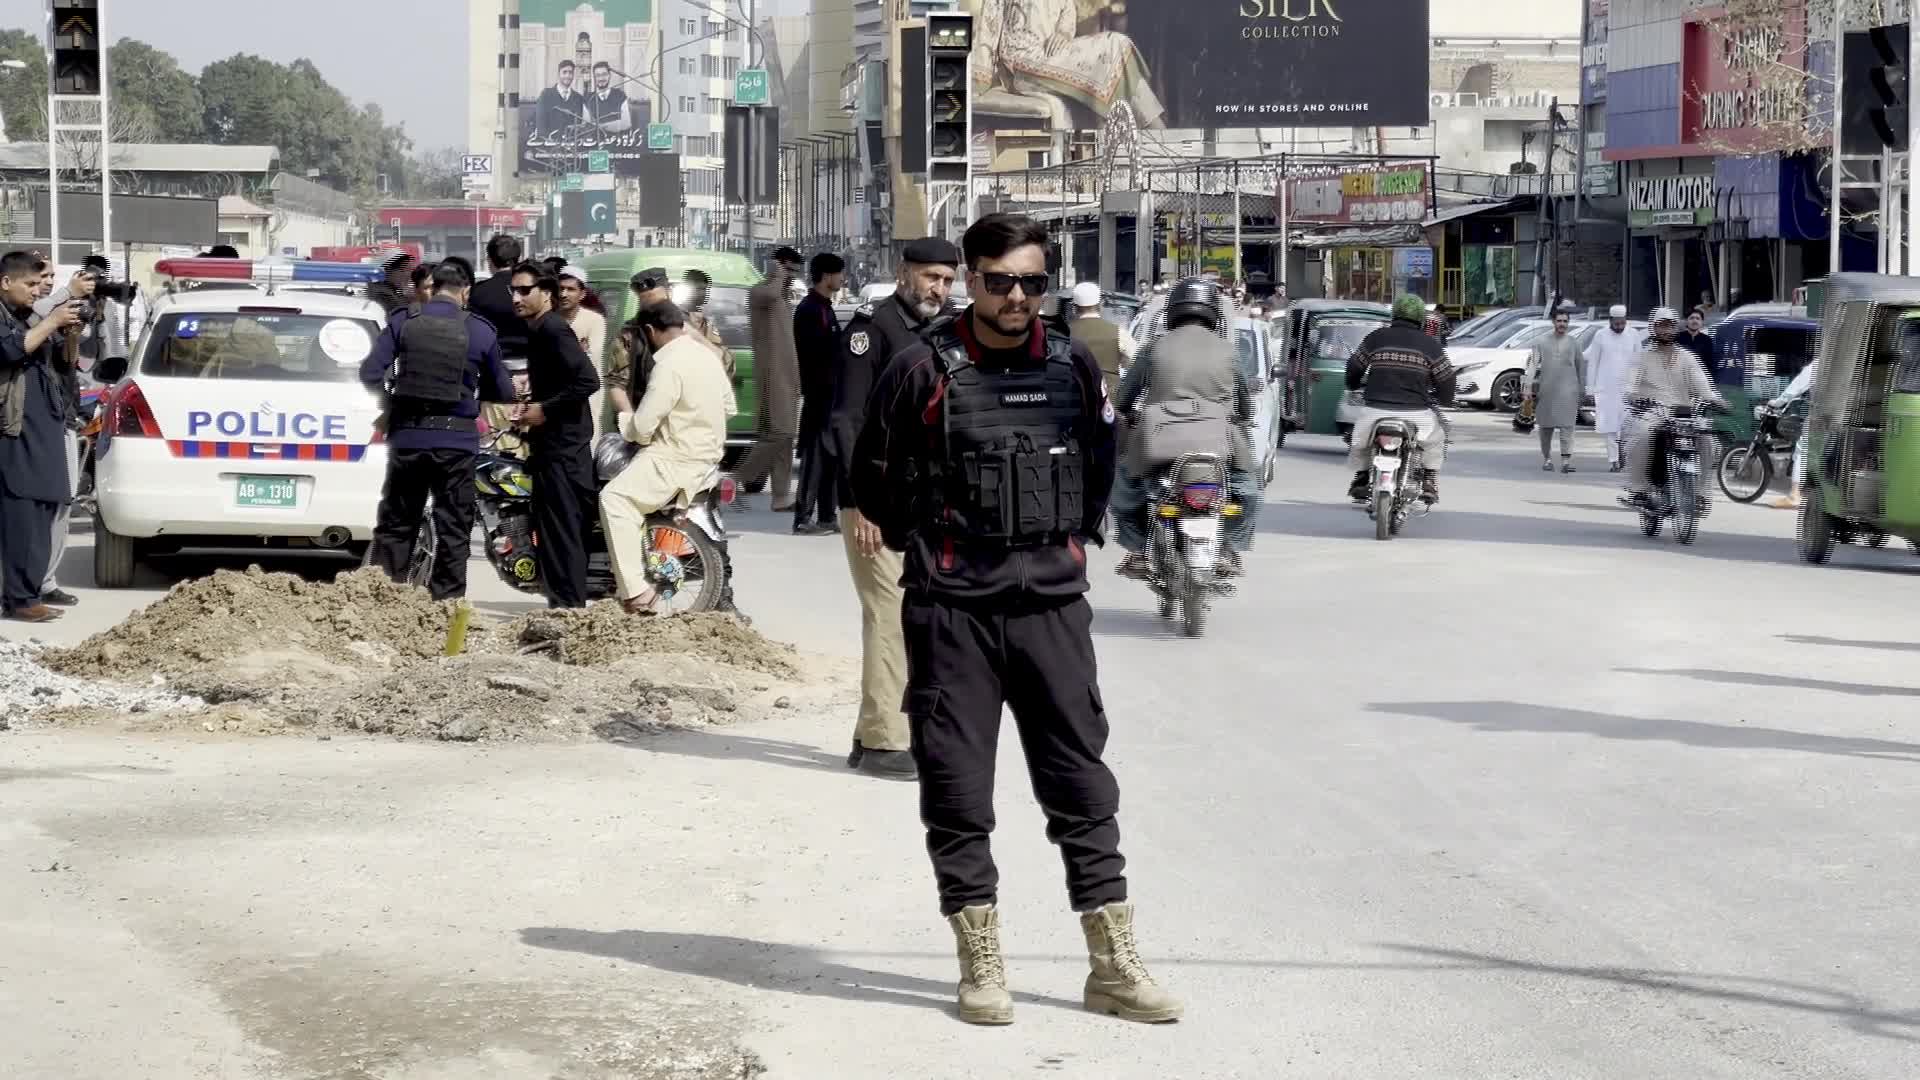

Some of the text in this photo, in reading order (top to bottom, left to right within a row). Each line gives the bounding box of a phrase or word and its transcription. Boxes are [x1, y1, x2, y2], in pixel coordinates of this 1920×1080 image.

[1242, 25, 1340, 39] COLLECTION
[1215, 105, 1239, 113] NOW
[1259, 104, 1299, 113] STORES
[1303, 103, 1325, 112] AND
[1329, 103, 1369, 111] ONLINE
[1628, 178, 1664, 211] NIZAM
[187, 410, 347, 440] POLICE
[269, 484, 293, 499] 1310
